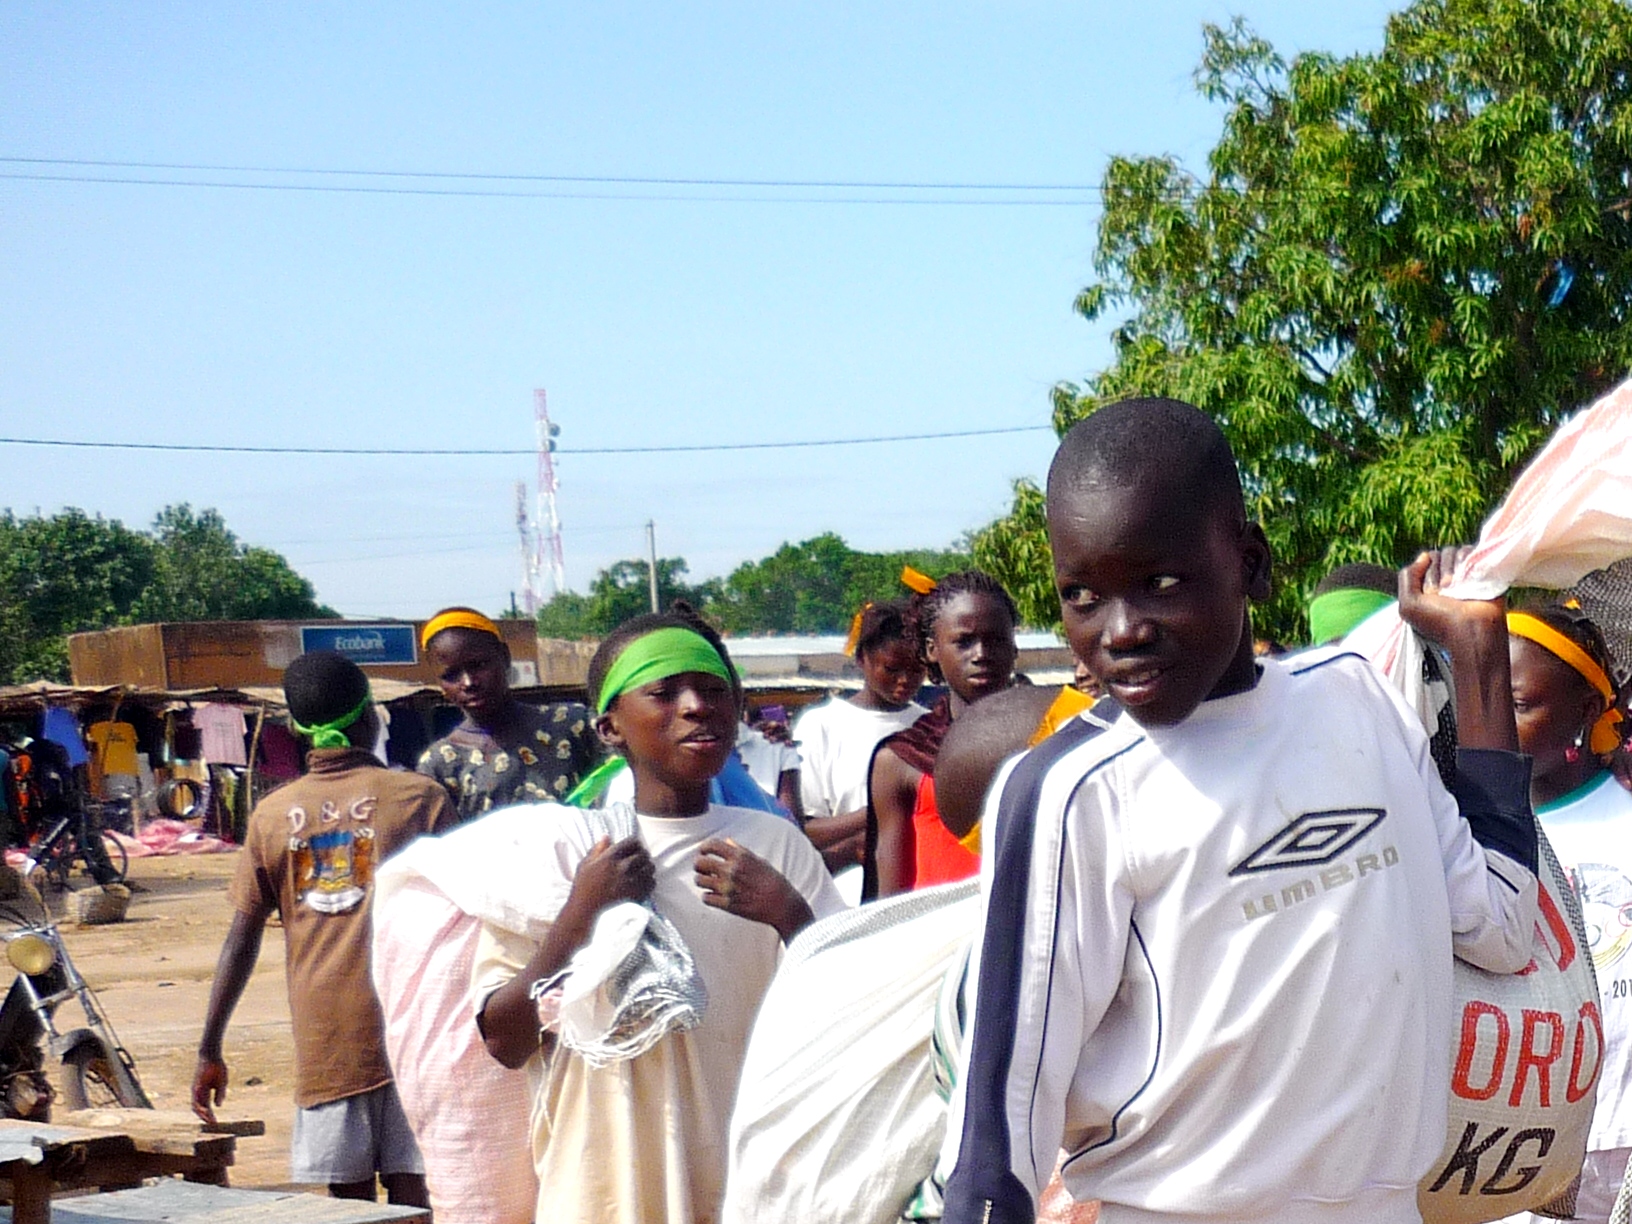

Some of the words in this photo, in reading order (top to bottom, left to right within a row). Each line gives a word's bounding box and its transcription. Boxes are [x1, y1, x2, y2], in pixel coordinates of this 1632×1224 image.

[334, 633, 385, 650] Ecobank
[287, 806, 306, 834] D
[322, 801, 341, 823] &
[350, 797, 378, 820] G
[1243, 845, 1399, 921] UMBRO
[1427, 1121, 1556, 1196] KG
